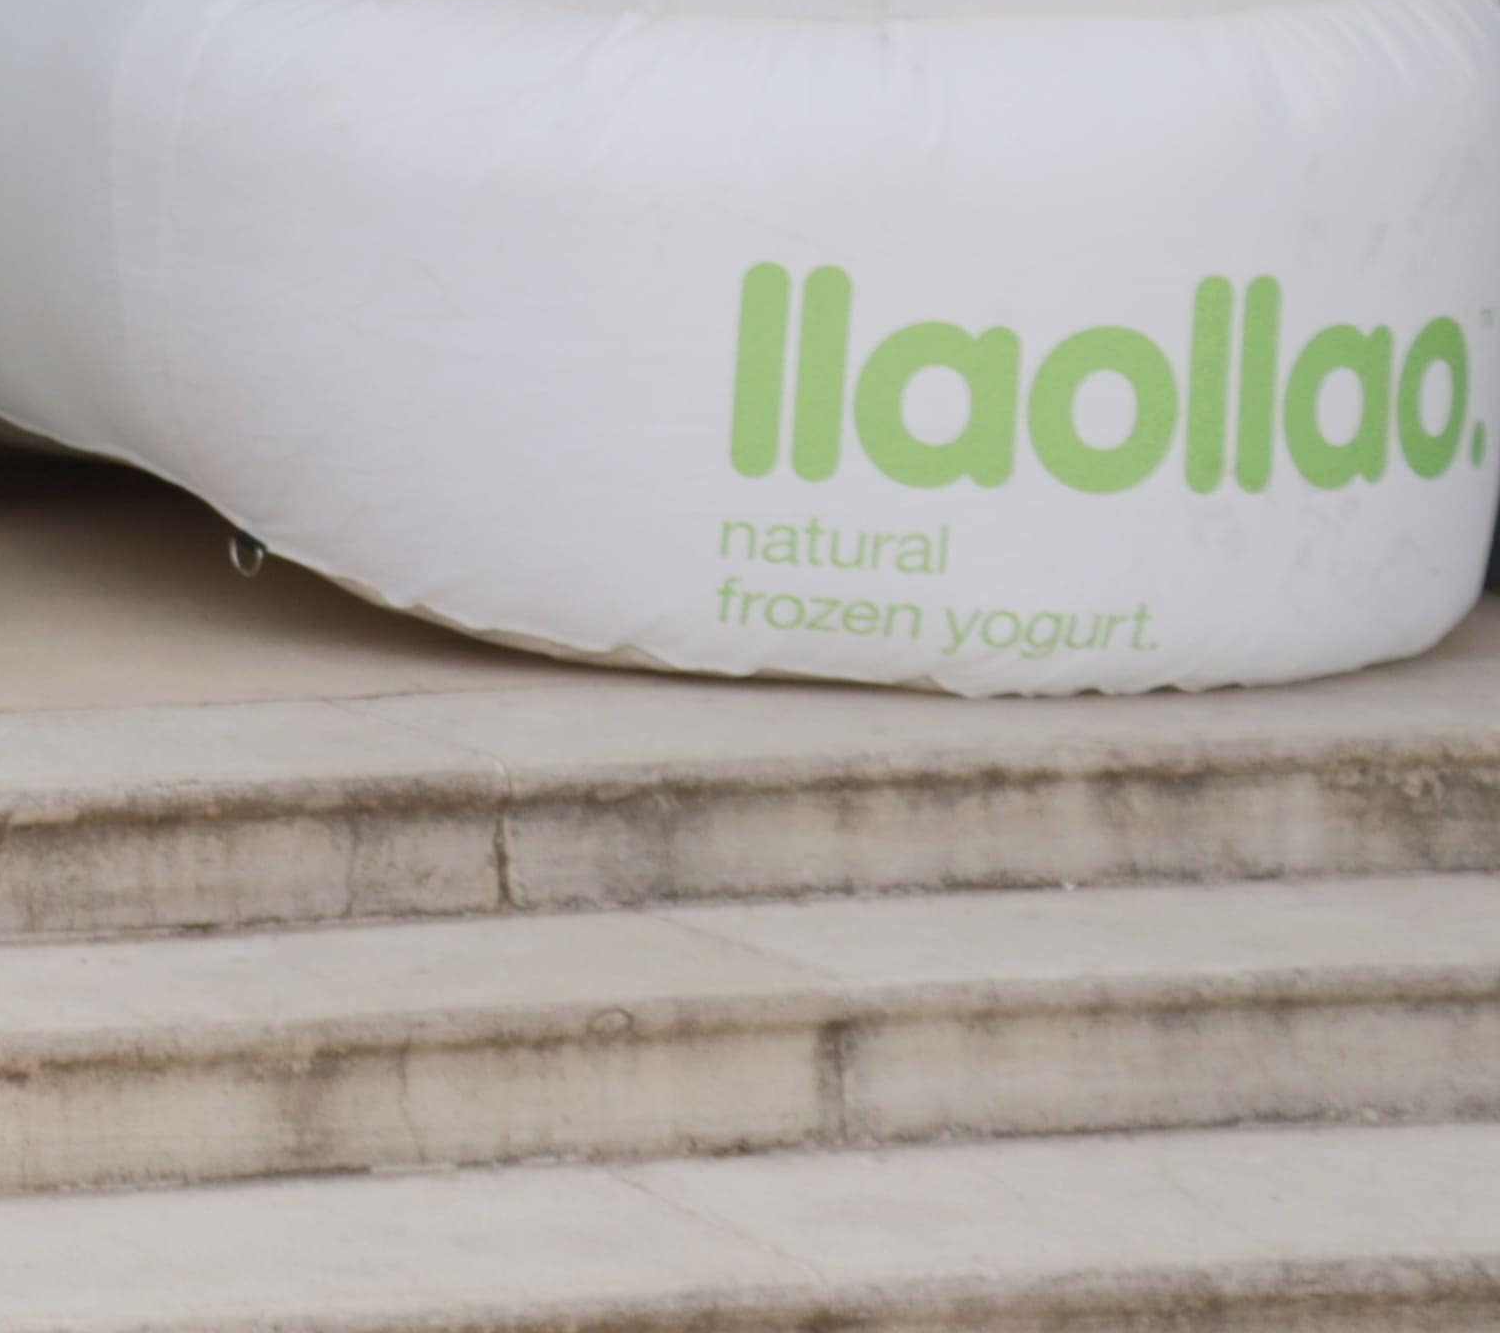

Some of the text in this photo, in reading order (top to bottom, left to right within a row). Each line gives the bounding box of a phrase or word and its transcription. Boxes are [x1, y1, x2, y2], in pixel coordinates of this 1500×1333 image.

[719, 516, 950, 574] natural
[715, 575, 1161, 659] frozen yogurt.
